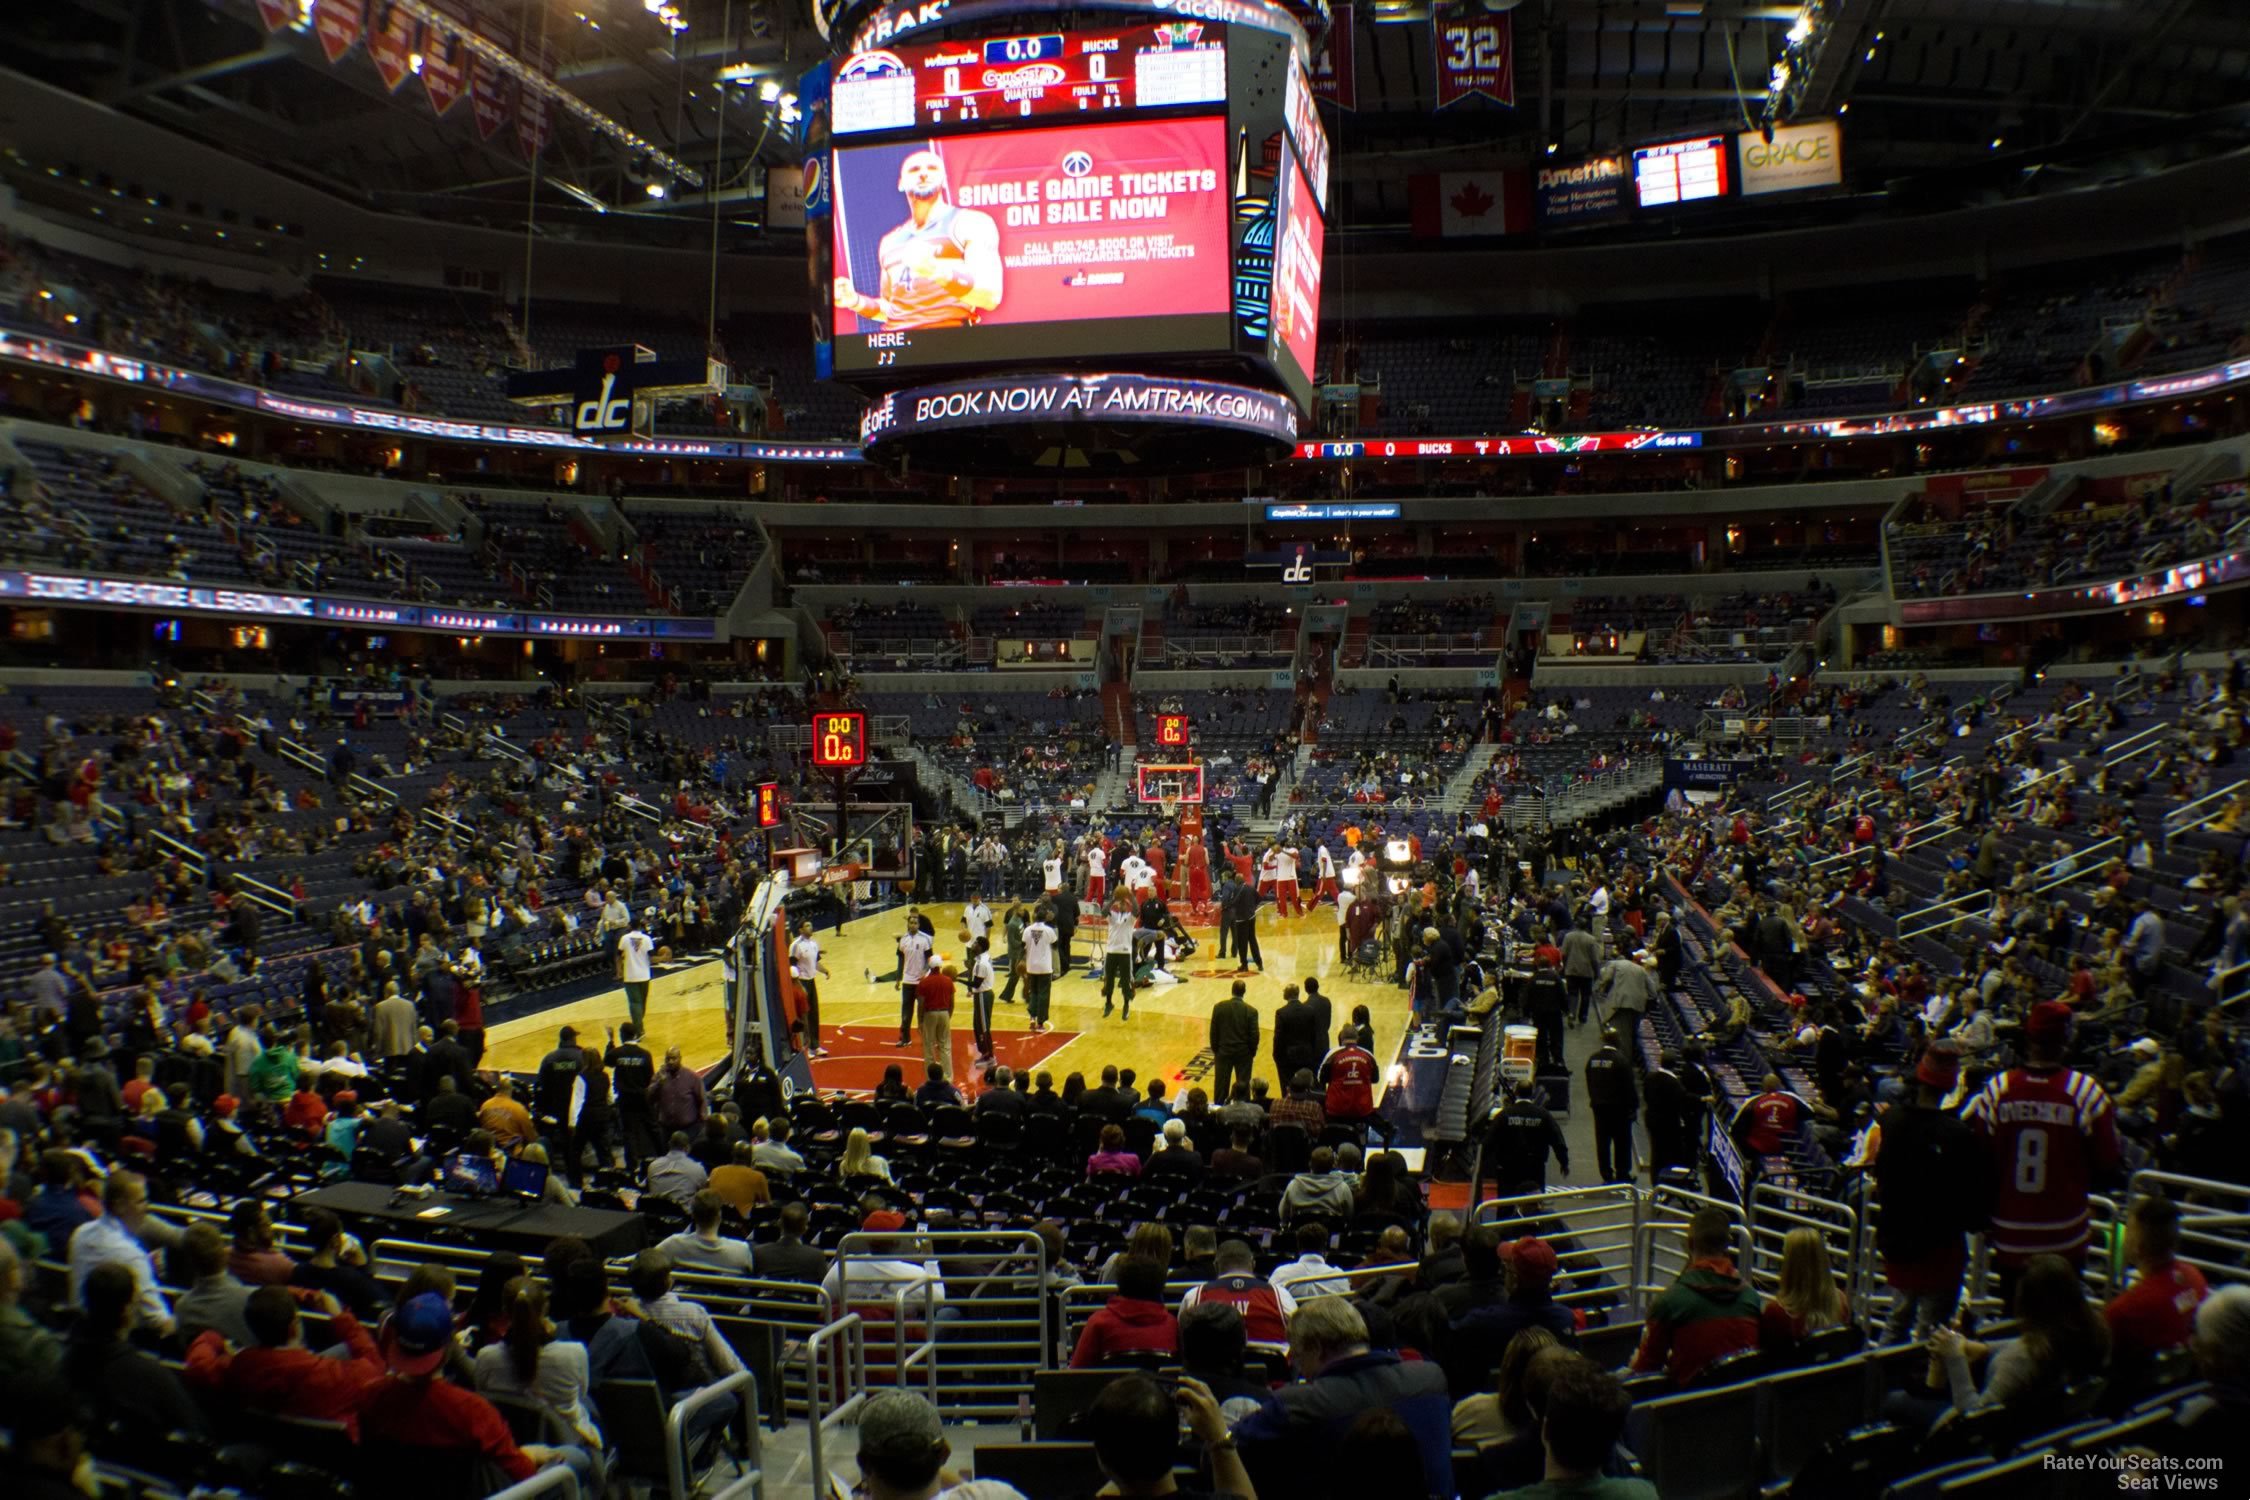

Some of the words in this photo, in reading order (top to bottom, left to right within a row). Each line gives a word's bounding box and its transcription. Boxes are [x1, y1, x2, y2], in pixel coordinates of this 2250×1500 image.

[1006, 39, 1041, 59] 0.0
[1082, 38, 1119, 52] BUCKS
[1446, 26, 1500, 70] 32
[1089, 54, 1105, 81] 0
[944, 67, 959, 95] 0
[1004, 87, 1044, 102] QUARTER
[1073, 85, 1097, 96] FOULS
[926, 99, 949, 109] FOULS
[1021, 100, 1031, 115] 0
[1079, 97, 1087, 109] 0
[933, 110, 941, 122] 0
[1746, 135, 1830, 171] GRACE
[822, 156, 830, 202] pepsi
[958, 180, 1039, 207] SINGLE
[1046, 175, 1113, 200] GAME
[1120, 169, 1217, 195] TICKETS
[1570, 187, 1617, 201] Hometown
[1007, 205, 1040, 227] ON
[1047, 200, 1102, 223] SALE
[1110, 197, 1167, 219] NOW
[1024, 243, 1047, 255] CALL
[1130, 237, 1144, 249] OR
[1147, 235, 1174, 248] VISIT
[1004, 246, 1194, 268] WASHINGTONWIZARDS.COM/TICKETS
[868, 332, 912, 348] HERE.
[576, 373, 630, 429] dc
[916, 390, 981, 422] BOOK
[988, 386, 1058, 414] NOW
[1061, 387, 1100, 410] AT
[1104, 387, 1263, 423] AMTRAK.COM
[1333, 444, 1353, 456] 0.0
[1385, 442, 1395, 456] 0
[1418, 443, 1452, 454] BUCKS
[1283, 554, 1311, 582] dc
[1080, 673, 1095, 682] 107
[1275, 672, 1290, 681] 106
[1480, 670, 1495, 680] 105
[825, 734, 852, 761] 0.0
[1682, 762, 1732, 772] MASERATI
[1525, 1117, 1542, 1127] STAFF
[2015, 1128, 2048, 1192] 8
